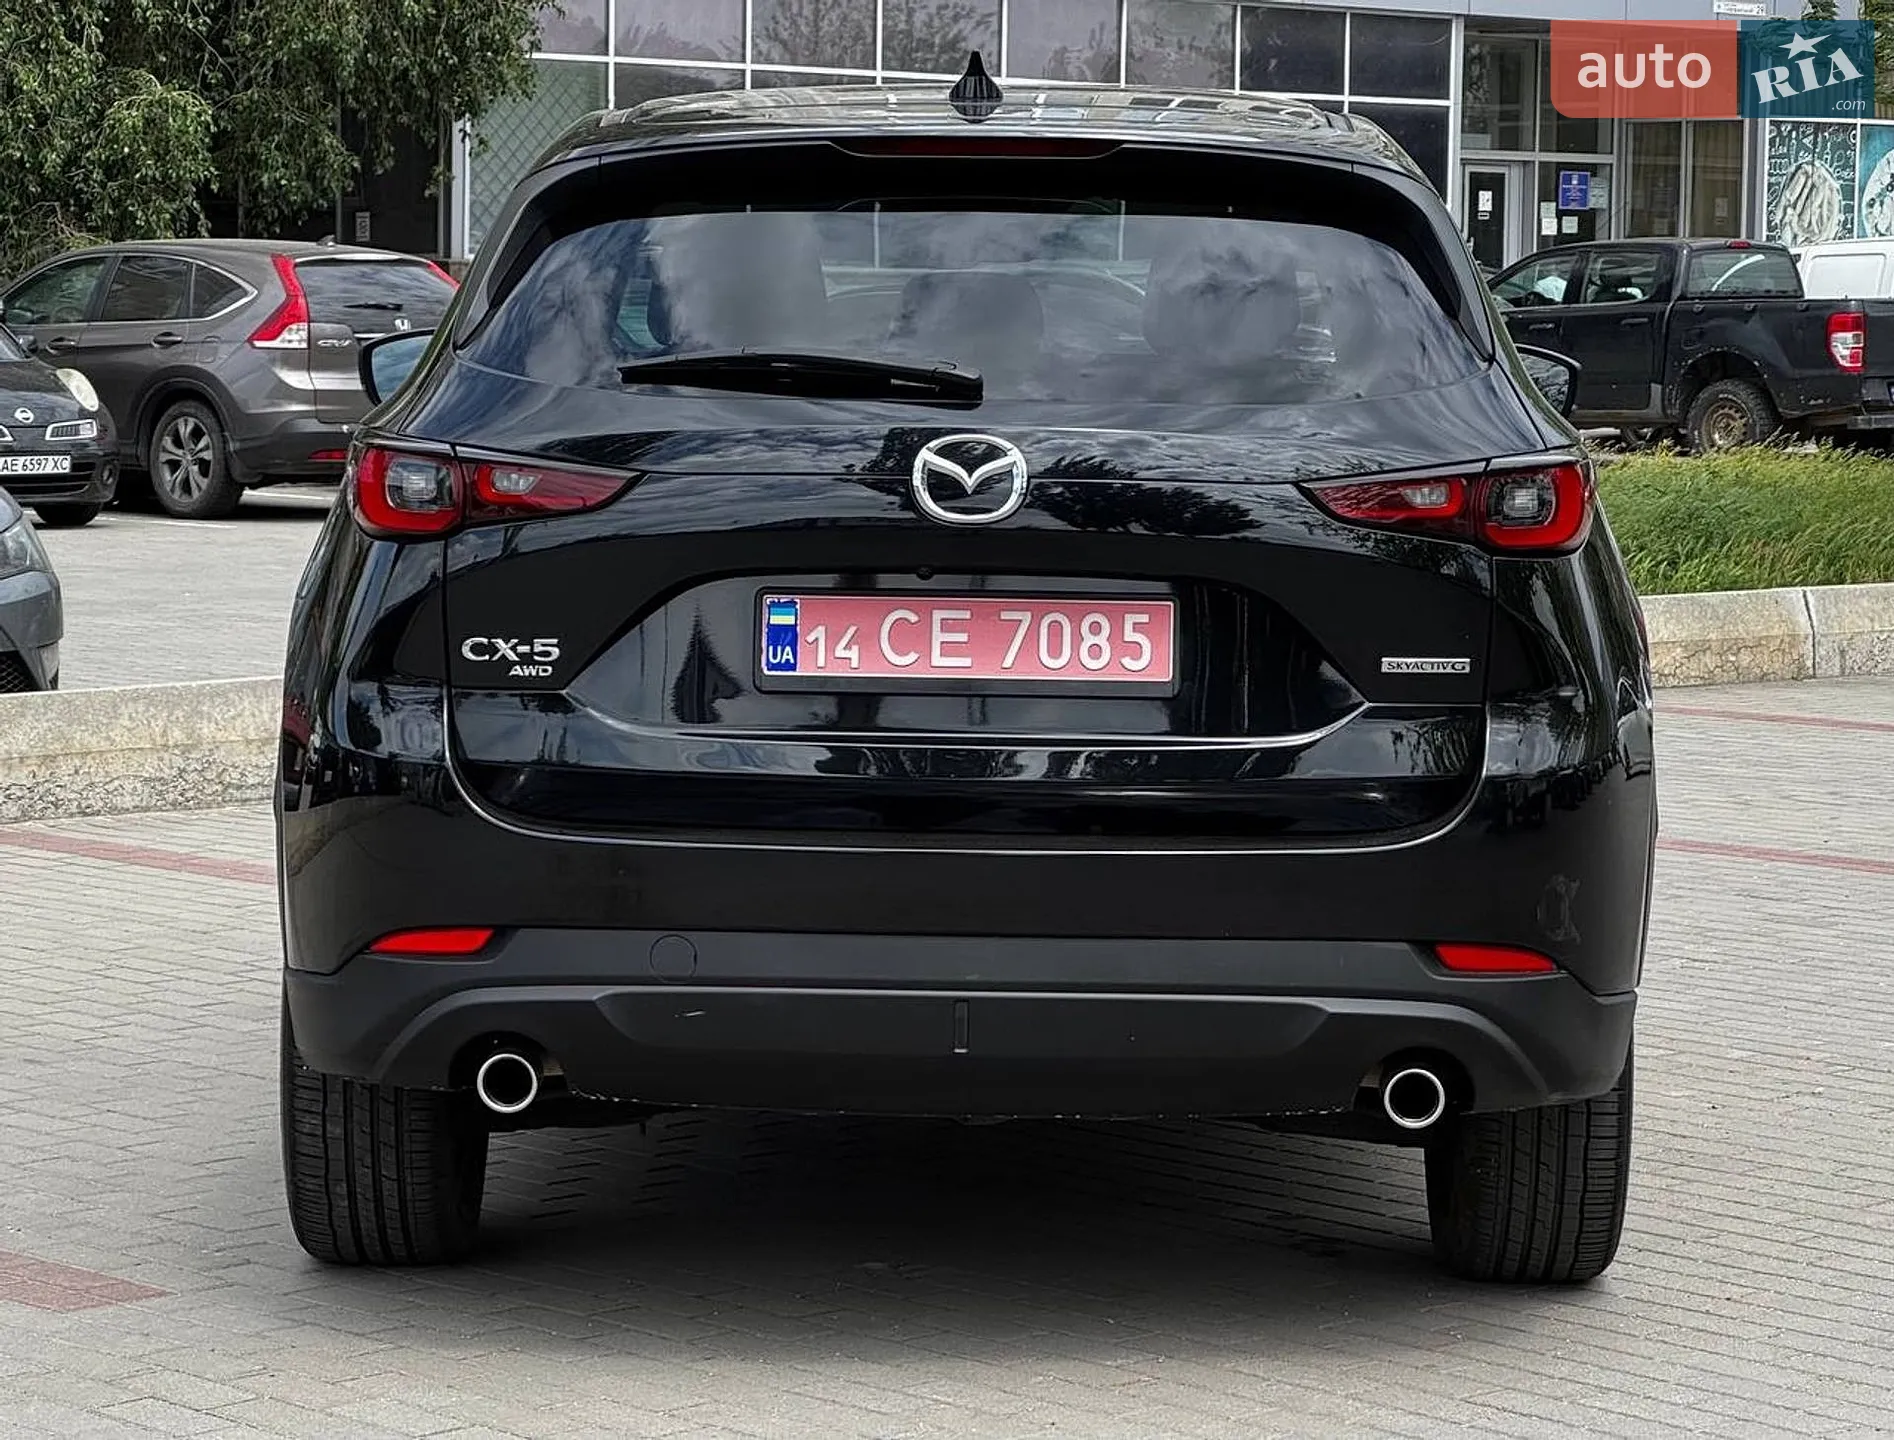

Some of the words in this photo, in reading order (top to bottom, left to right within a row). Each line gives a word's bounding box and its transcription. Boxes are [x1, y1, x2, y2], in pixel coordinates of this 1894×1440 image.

[1, 458, 19, 472] AE
[22, 457, 49, 472] 6597
[51, 457, 68, 471] XC
[461, 636, 561, 662] CX-5
[805, 625, 860, 669] 14
[880, 608, 972, 669] CE
[999, 610, 1152, 672] 7085
[768, 646, 795, 664] UA
[508, 664, 553, 677] AWD
